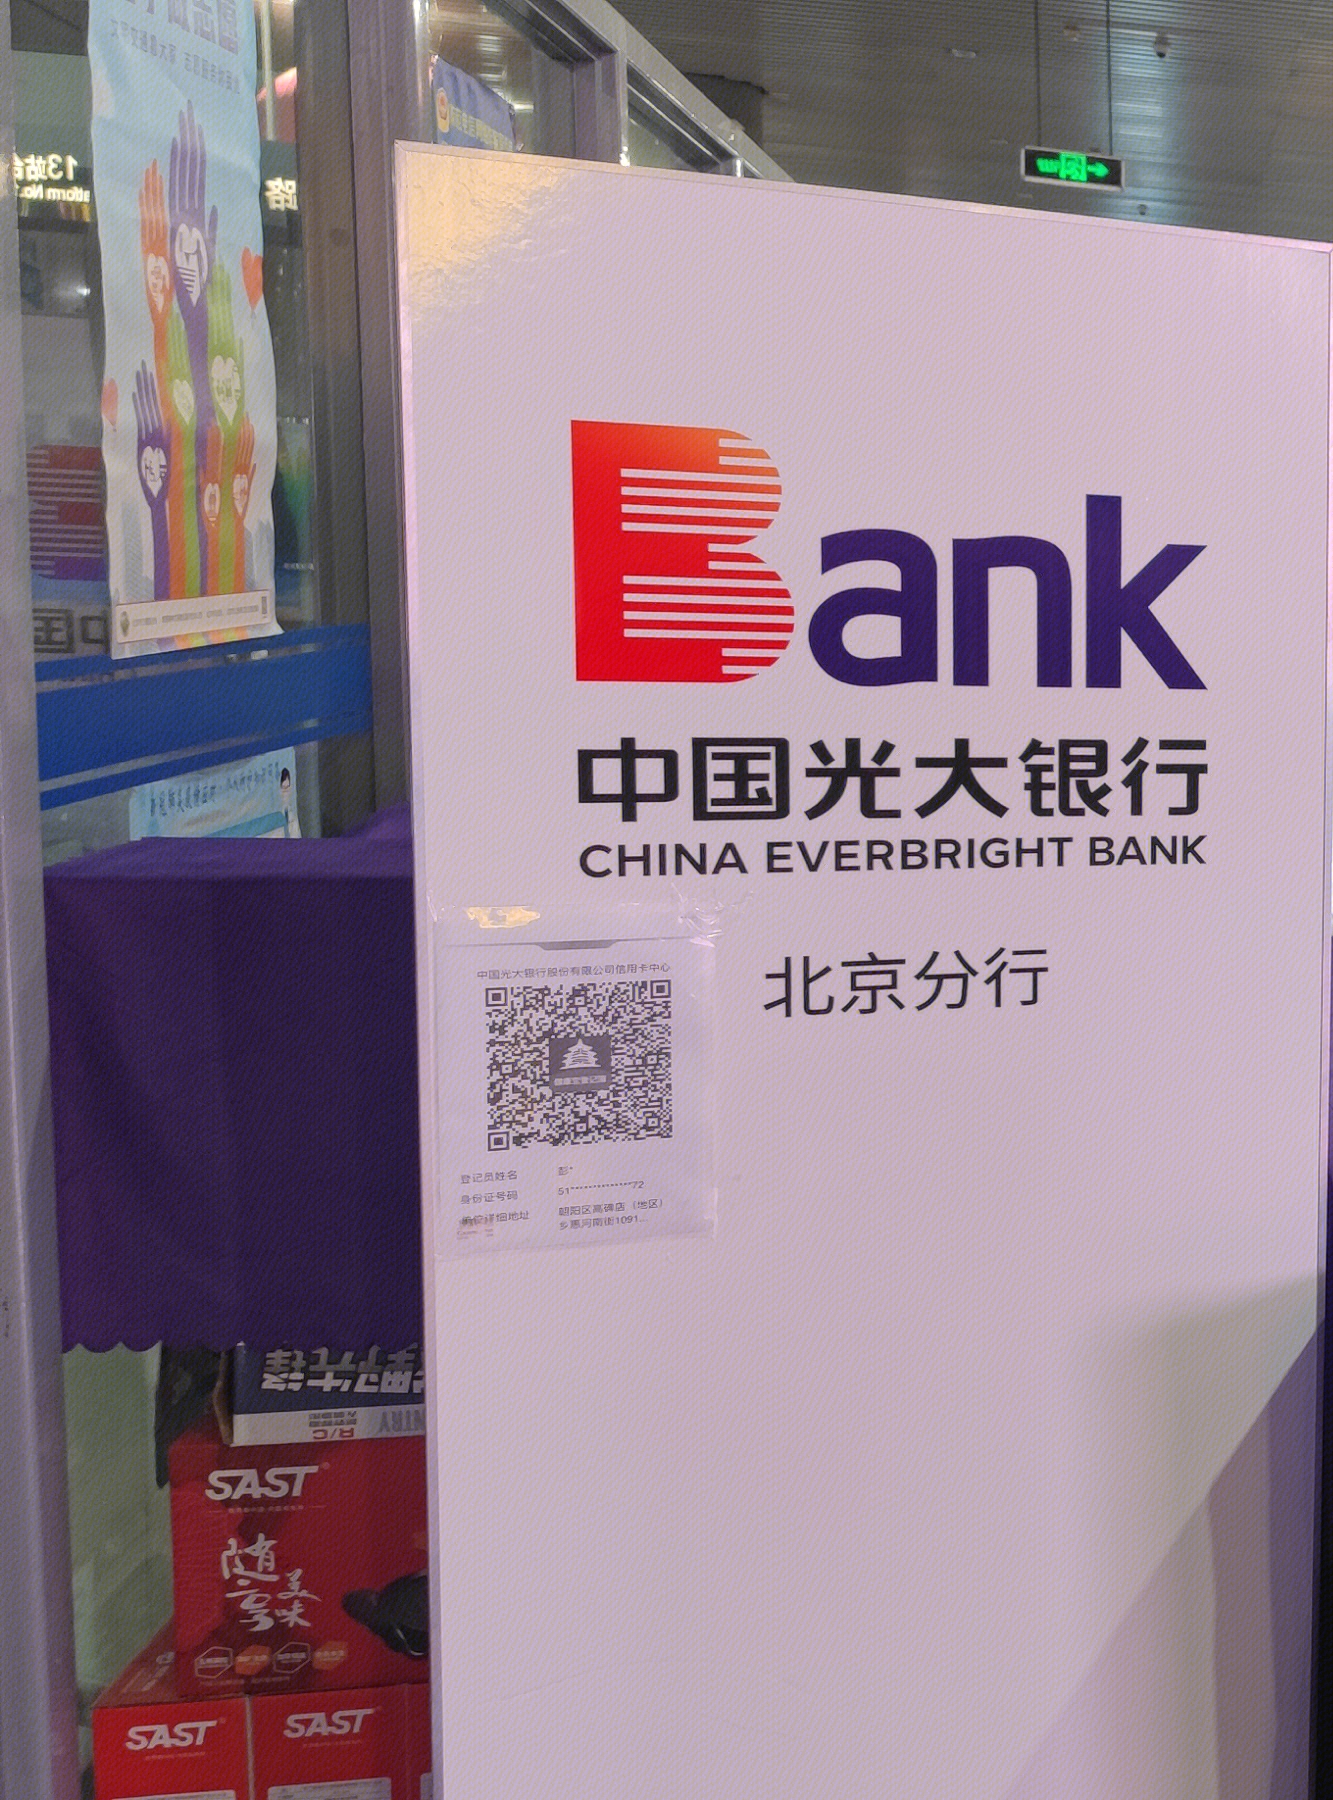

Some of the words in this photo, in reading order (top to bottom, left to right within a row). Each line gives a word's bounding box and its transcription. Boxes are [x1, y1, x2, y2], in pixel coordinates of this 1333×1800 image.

[571, 419, 1208, 690] Bank
[577, 736, 1209, 823] 中国光大银行
[579, 843, 748, 879] CHINA
[767, 837, 1073, 874] EVERBRIGHT
[1088, 834, 1207, 868] BANK
[477, 962, 671, 981] 中国光大银行股份有限公司信用卡中心
[763, 946, 1050, 1019] 北京分行
[461, 1170, 518, 1184] 登记员姓名
[461, 1190, 518, 1205] 身份证号码
[205, 1465, 319, 1501] SAST
[126, 1720, 218, 1751] SAST
[284, 1708, 375, 1738] SAST
